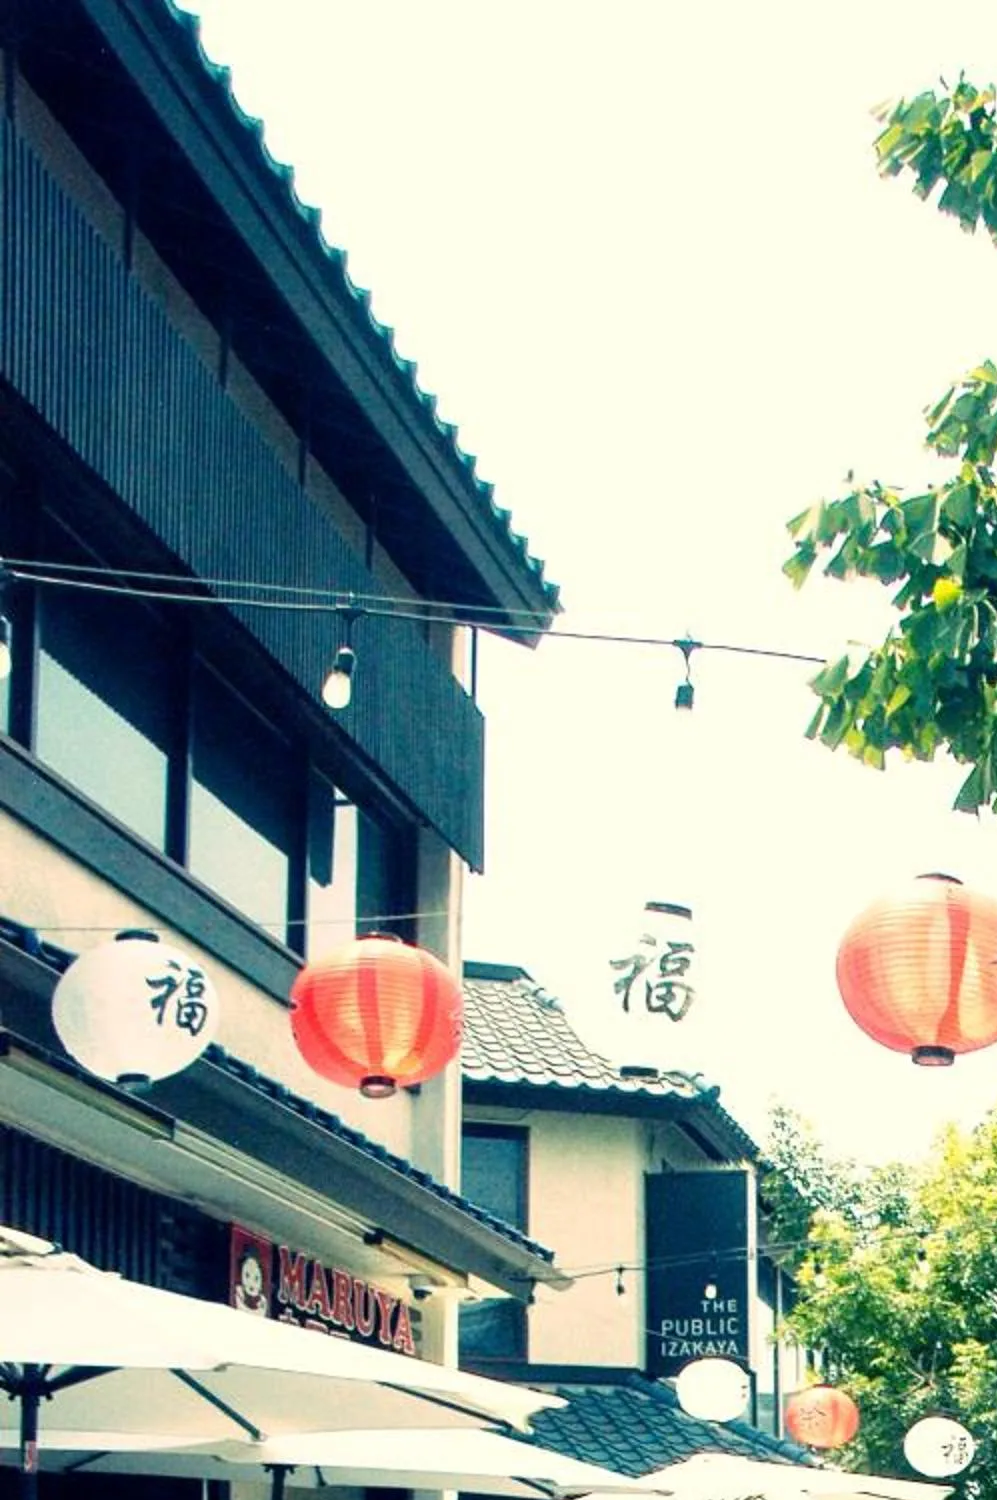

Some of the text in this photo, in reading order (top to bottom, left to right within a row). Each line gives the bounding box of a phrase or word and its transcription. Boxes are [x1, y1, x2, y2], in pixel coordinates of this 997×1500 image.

[144, 959, 208, 1037] 福
[609, 933, 695, 1022] 福
[278, 1245, 415, 1355] MARUYA
[700, 1299, 737, 1313] THE
[661, 1318, 739, 1337] PUBLIC
[661, 1340, 739, 1357] IZAKAYA
